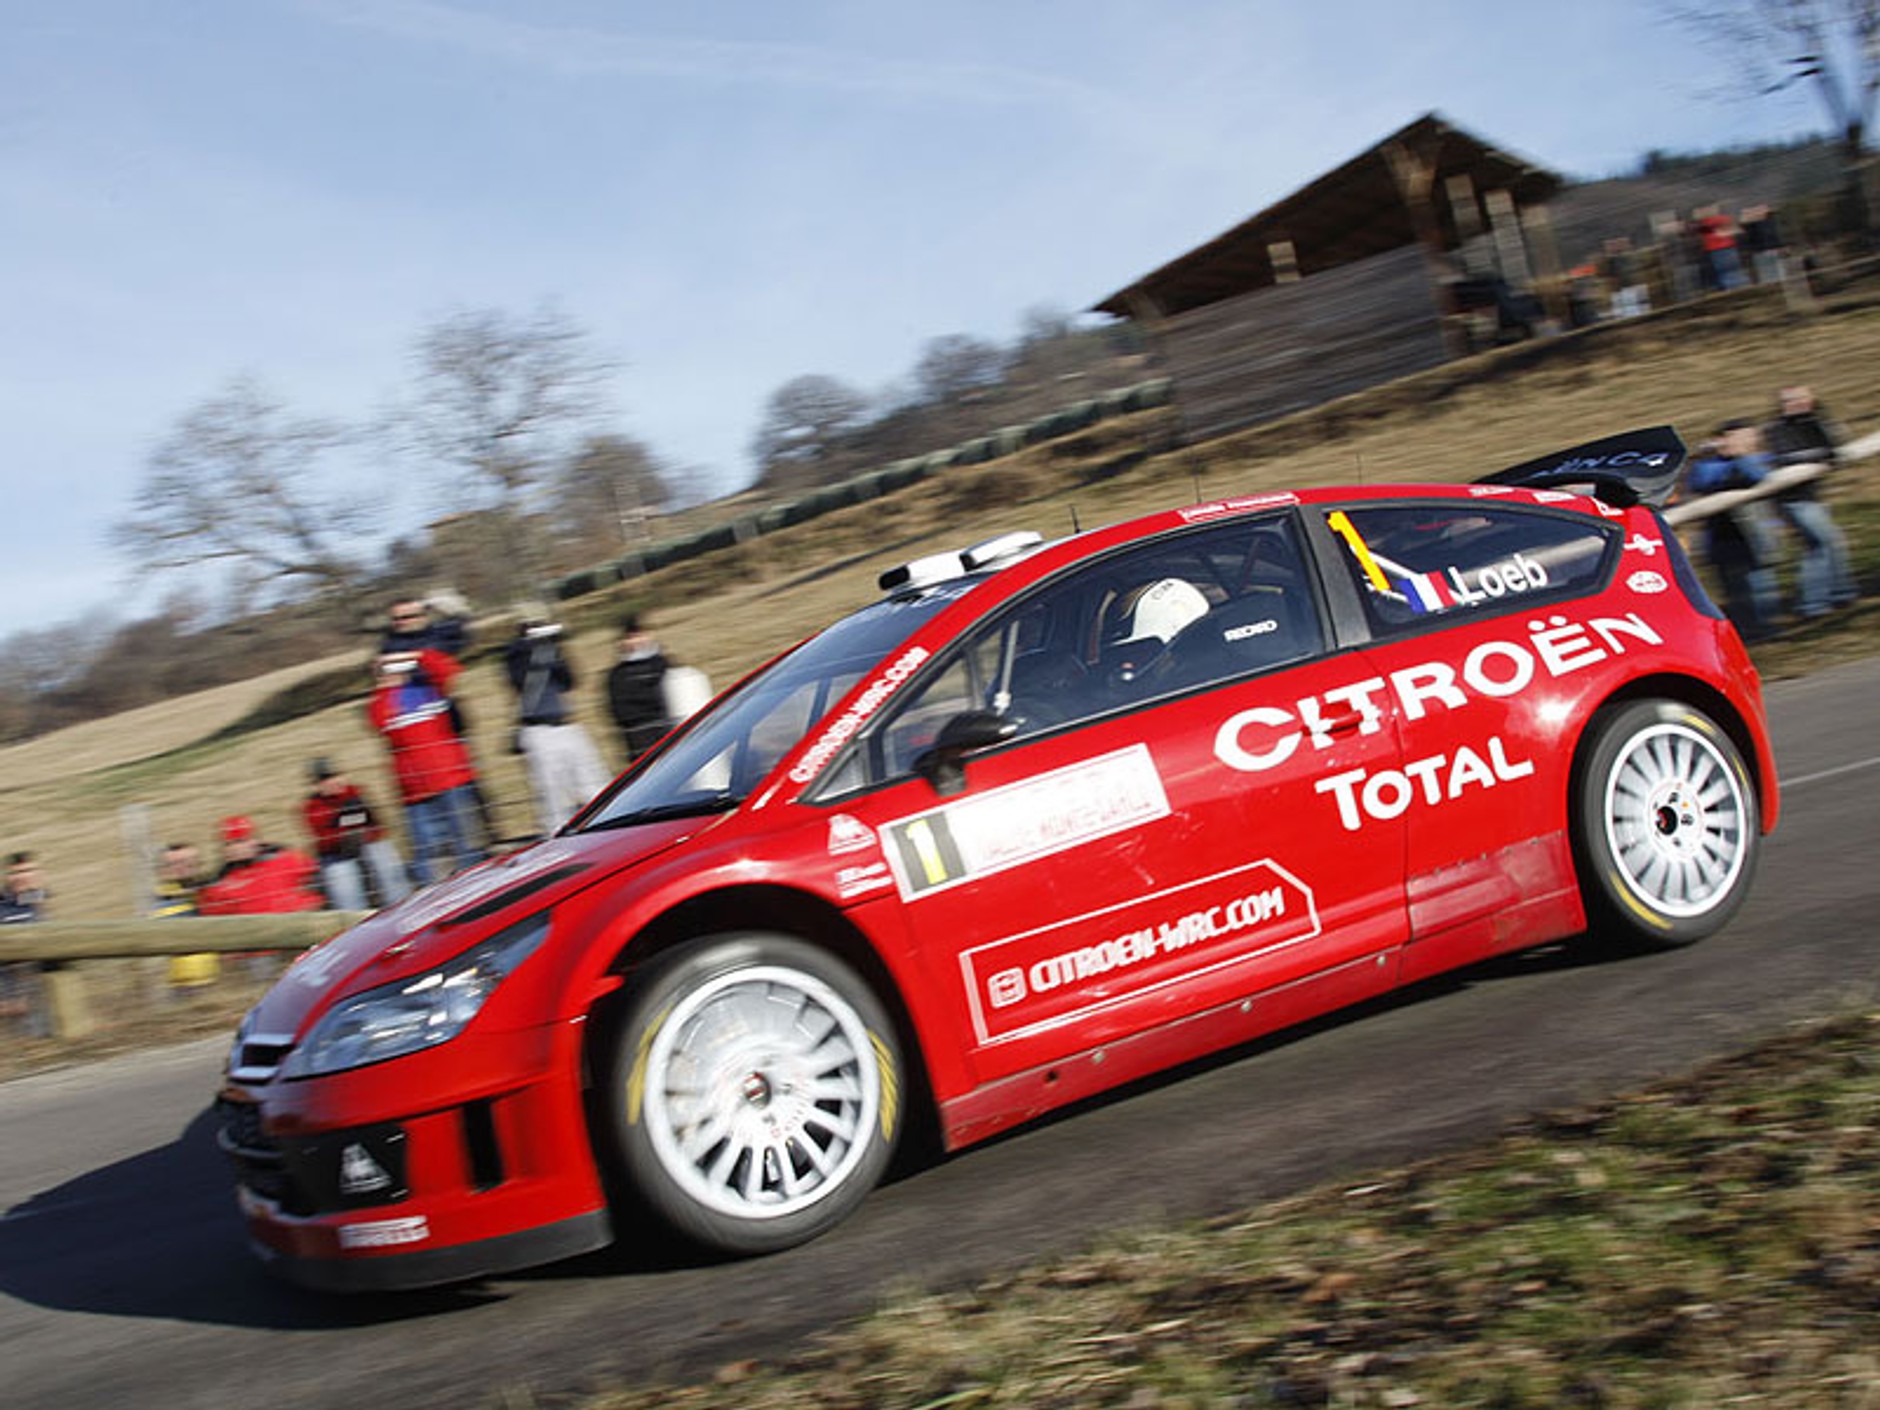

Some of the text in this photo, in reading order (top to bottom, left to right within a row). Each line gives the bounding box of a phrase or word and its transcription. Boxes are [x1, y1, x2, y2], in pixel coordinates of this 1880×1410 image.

[1327, 510, 1391, 592] 1
[1448, 552, 1549, 602] Loeb
[1213, 613, 1663, 772] CITROËN
[1314, 736, 1535, 830] TOTAL
[906, 819, 949, 886] 1
[1029, 886, 1286, 992] CITROEN-WRC.COM
